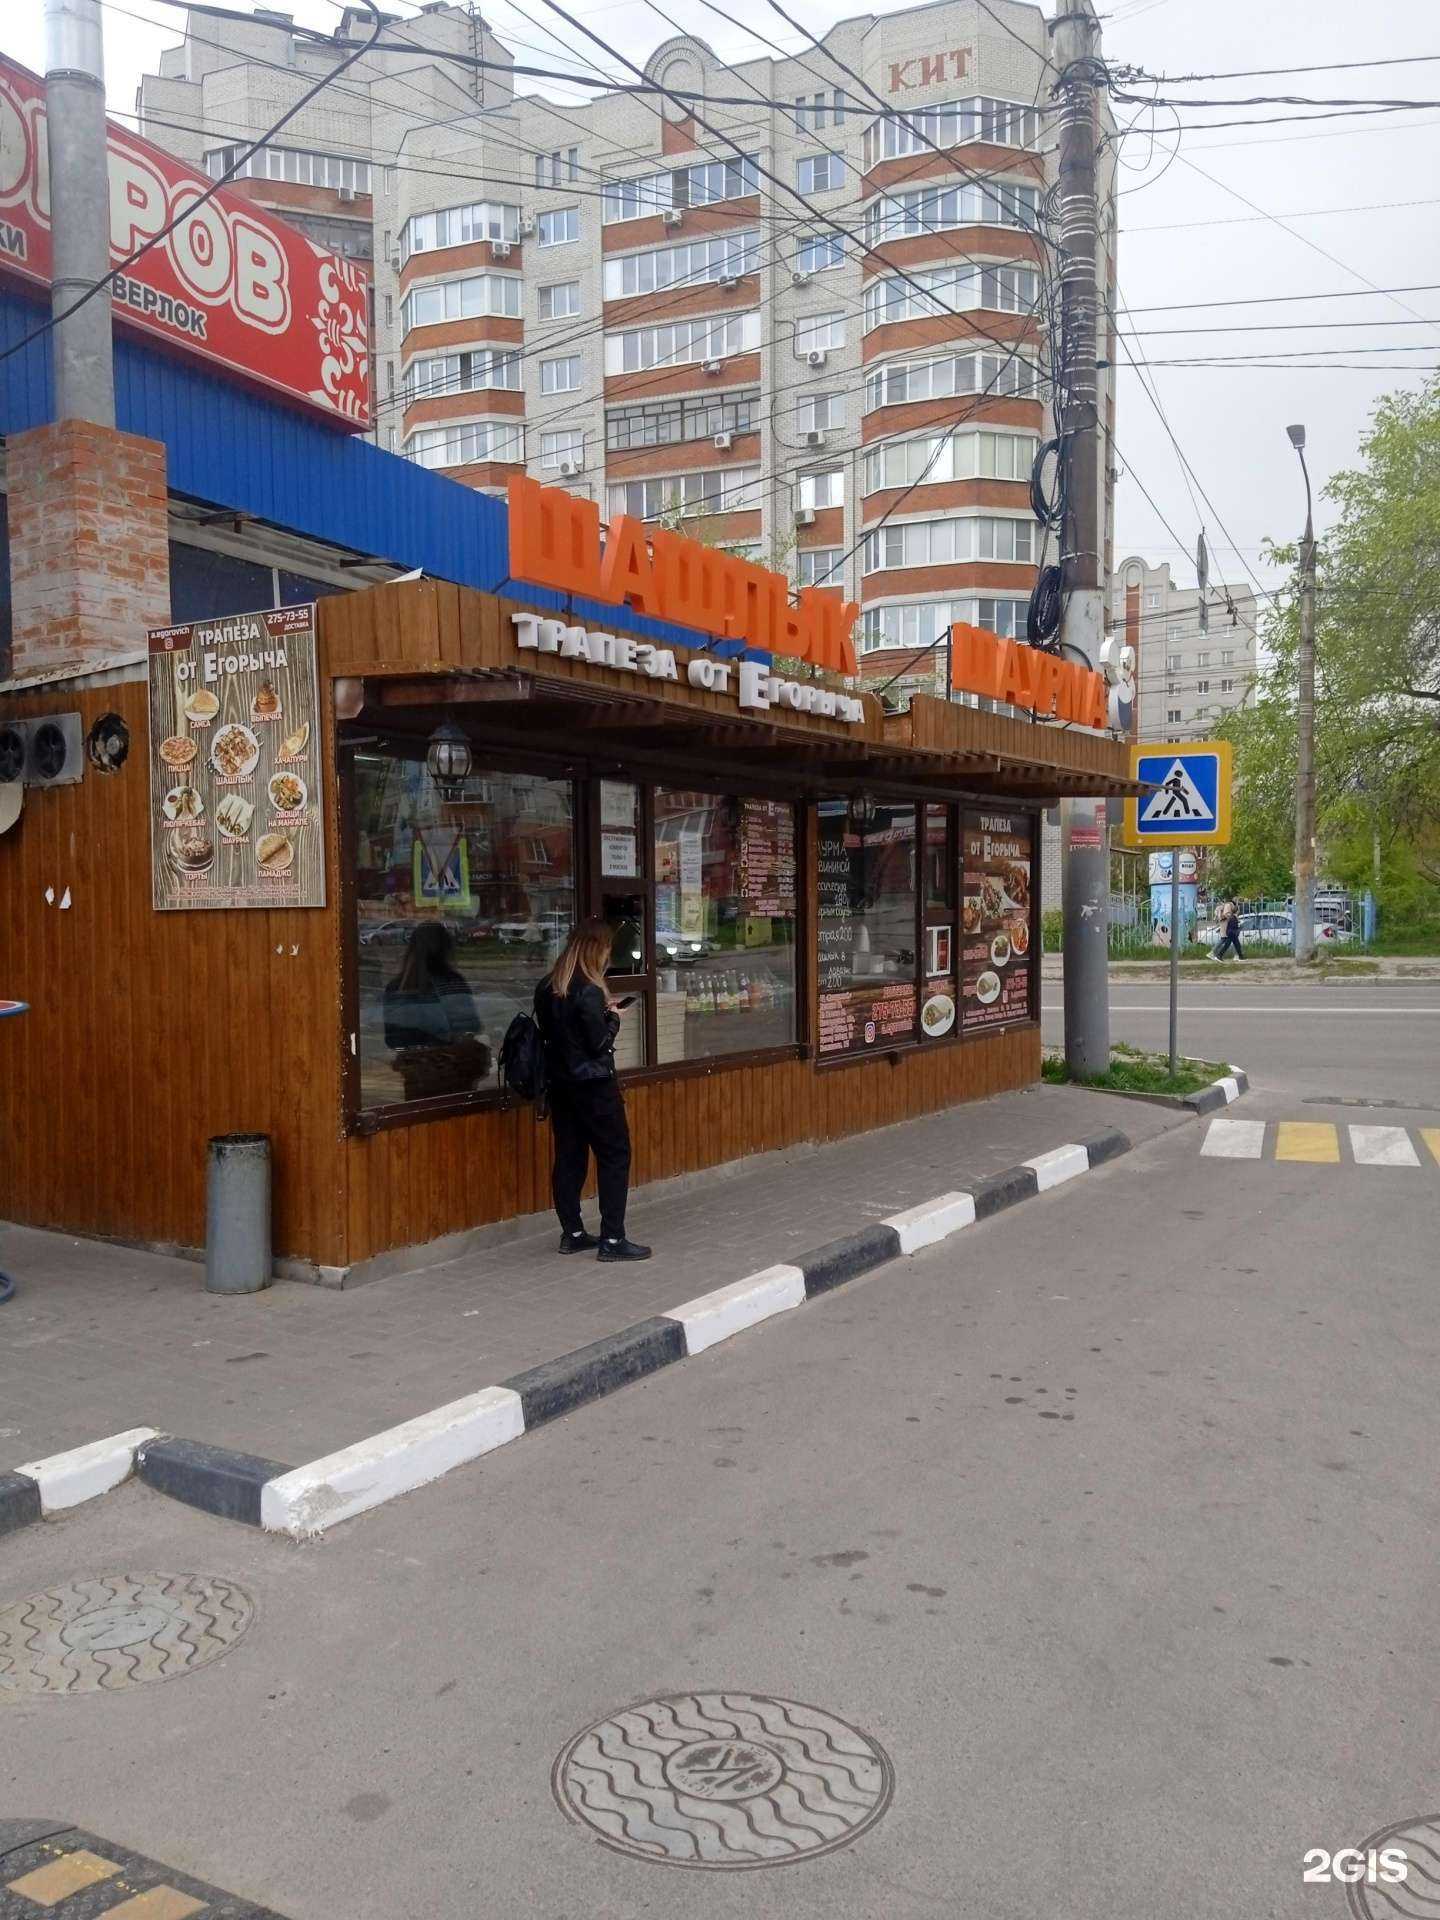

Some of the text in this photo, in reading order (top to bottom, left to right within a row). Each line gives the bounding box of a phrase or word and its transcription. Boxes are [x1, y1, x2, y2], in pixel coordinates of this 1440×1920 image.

[889, 48, 972, 94] КИТ
[112, 274, 207, 339] ВЕРЛОК
[508, 473, 861, 676] ШАШЛЫК
[267, 608, 309, 625] 275-73-55
[150, 626, 190, 641] a.egorovich
[198, 623, 261, 647] ТРАПЕЗА
[176, 648, 289, 683] ОТ ЕГОРЫЧА
[511, 611, 866, 725] ТРАПЕЗА ОТ ЕГОРЫЧА
[950, 621, 1107, 729] ШАУРМА
[215, 775, 254, 786] ШАШЛЫК
[980, 816, 1012, 833] ТРАПЕЗА
[970, 835, 1020, 863] ОТ ЕГОРЫЧА
